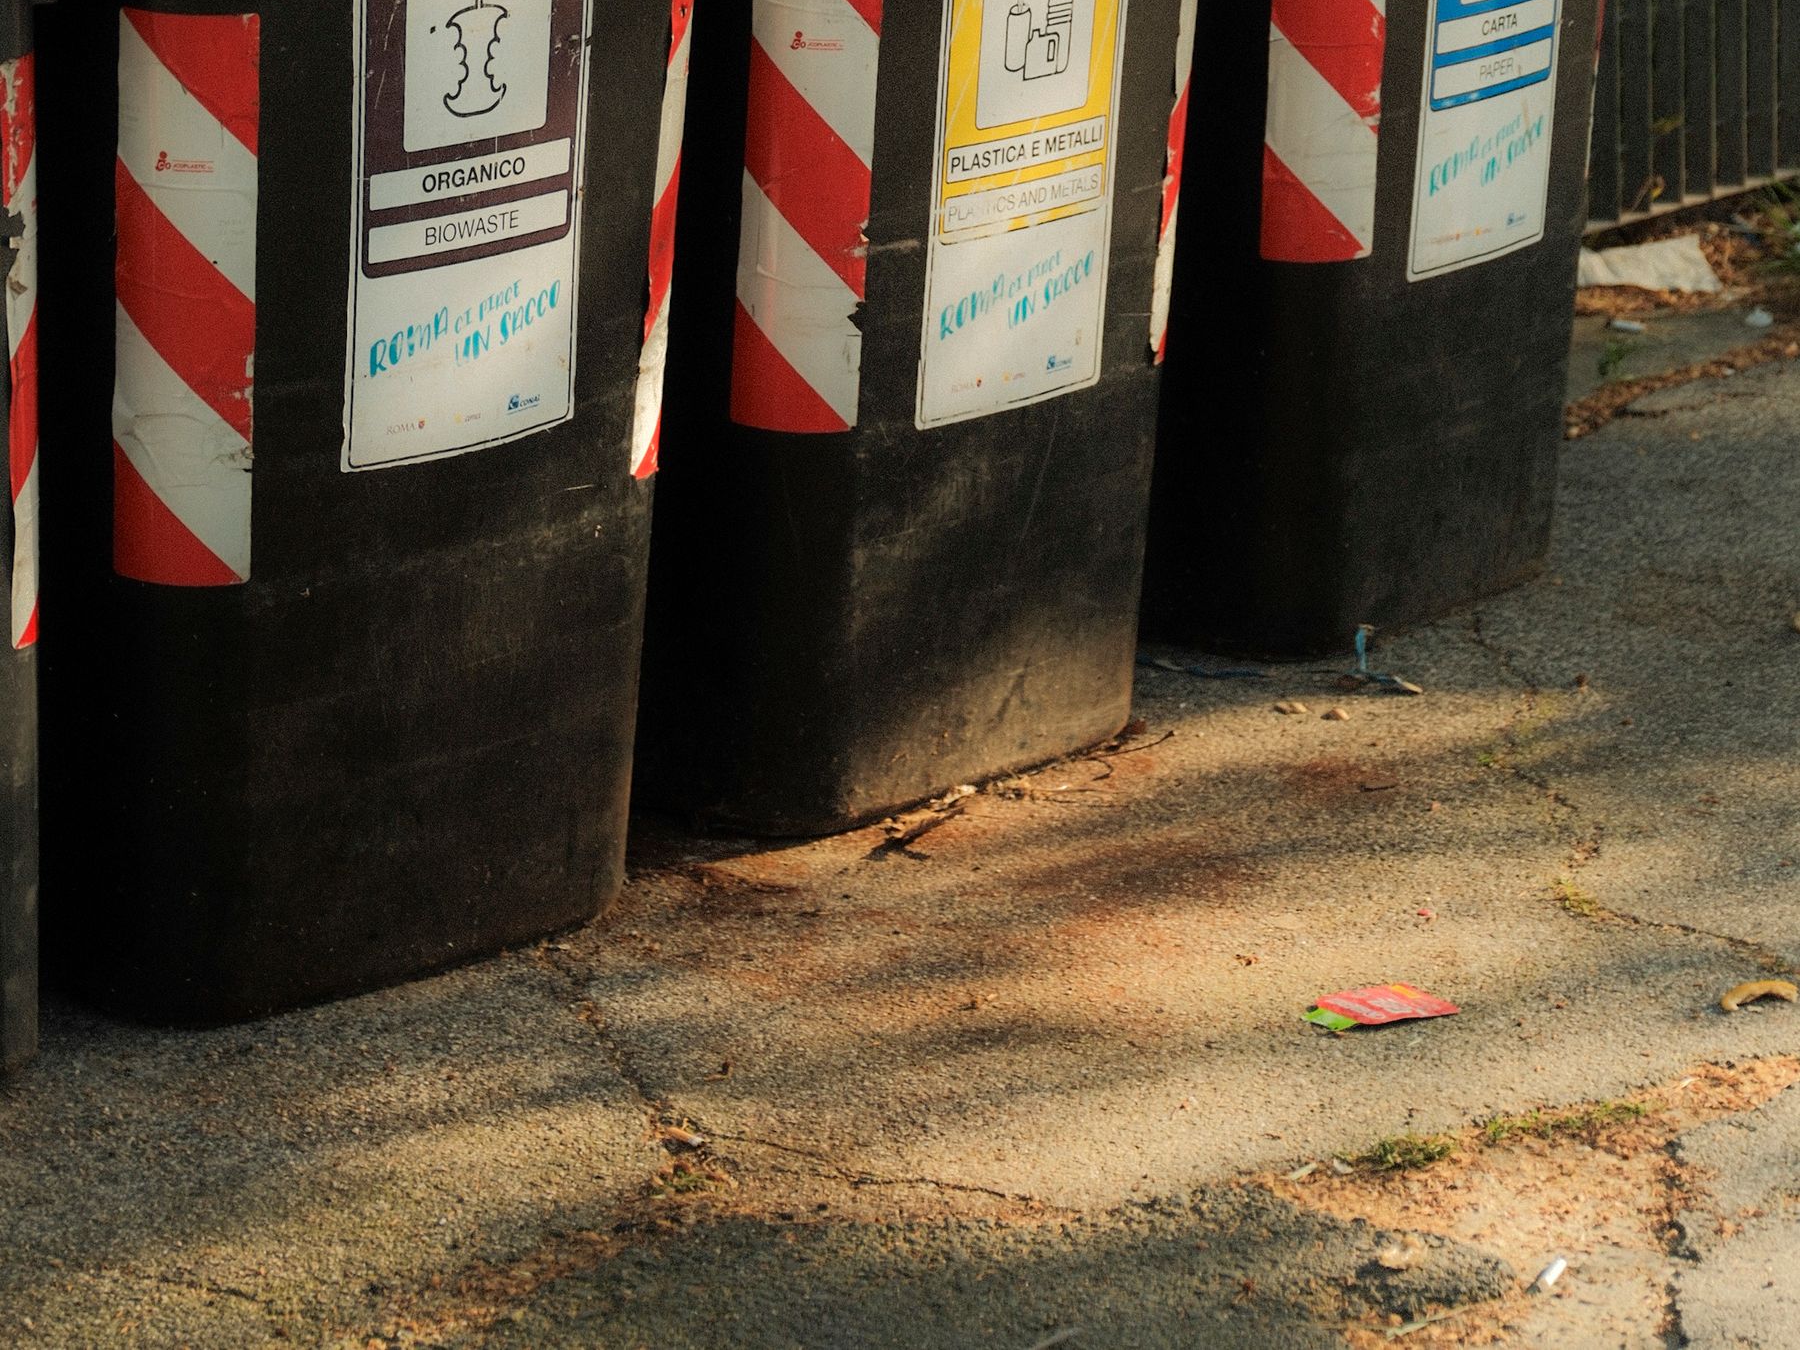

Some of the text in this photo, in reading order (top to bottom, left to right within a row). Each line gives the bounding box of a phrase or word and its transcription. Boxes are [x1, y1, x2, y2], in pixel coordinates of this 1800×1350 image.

[1481, 13, 1518, 36] CARTA
[1479, 57, 1514, 80] PAPER
[950, 125, 1103, 174] PLASTICA E METALLI
[422, 156, 526, 194] ORGANICO
[949, 173, 1099, 223] PLAICS AND METALS
[425, 209, 520, 246] BIOWASTE
[369, 305, 449, 378] ROMA
[455, 279, 562, 367] UN SACCO
